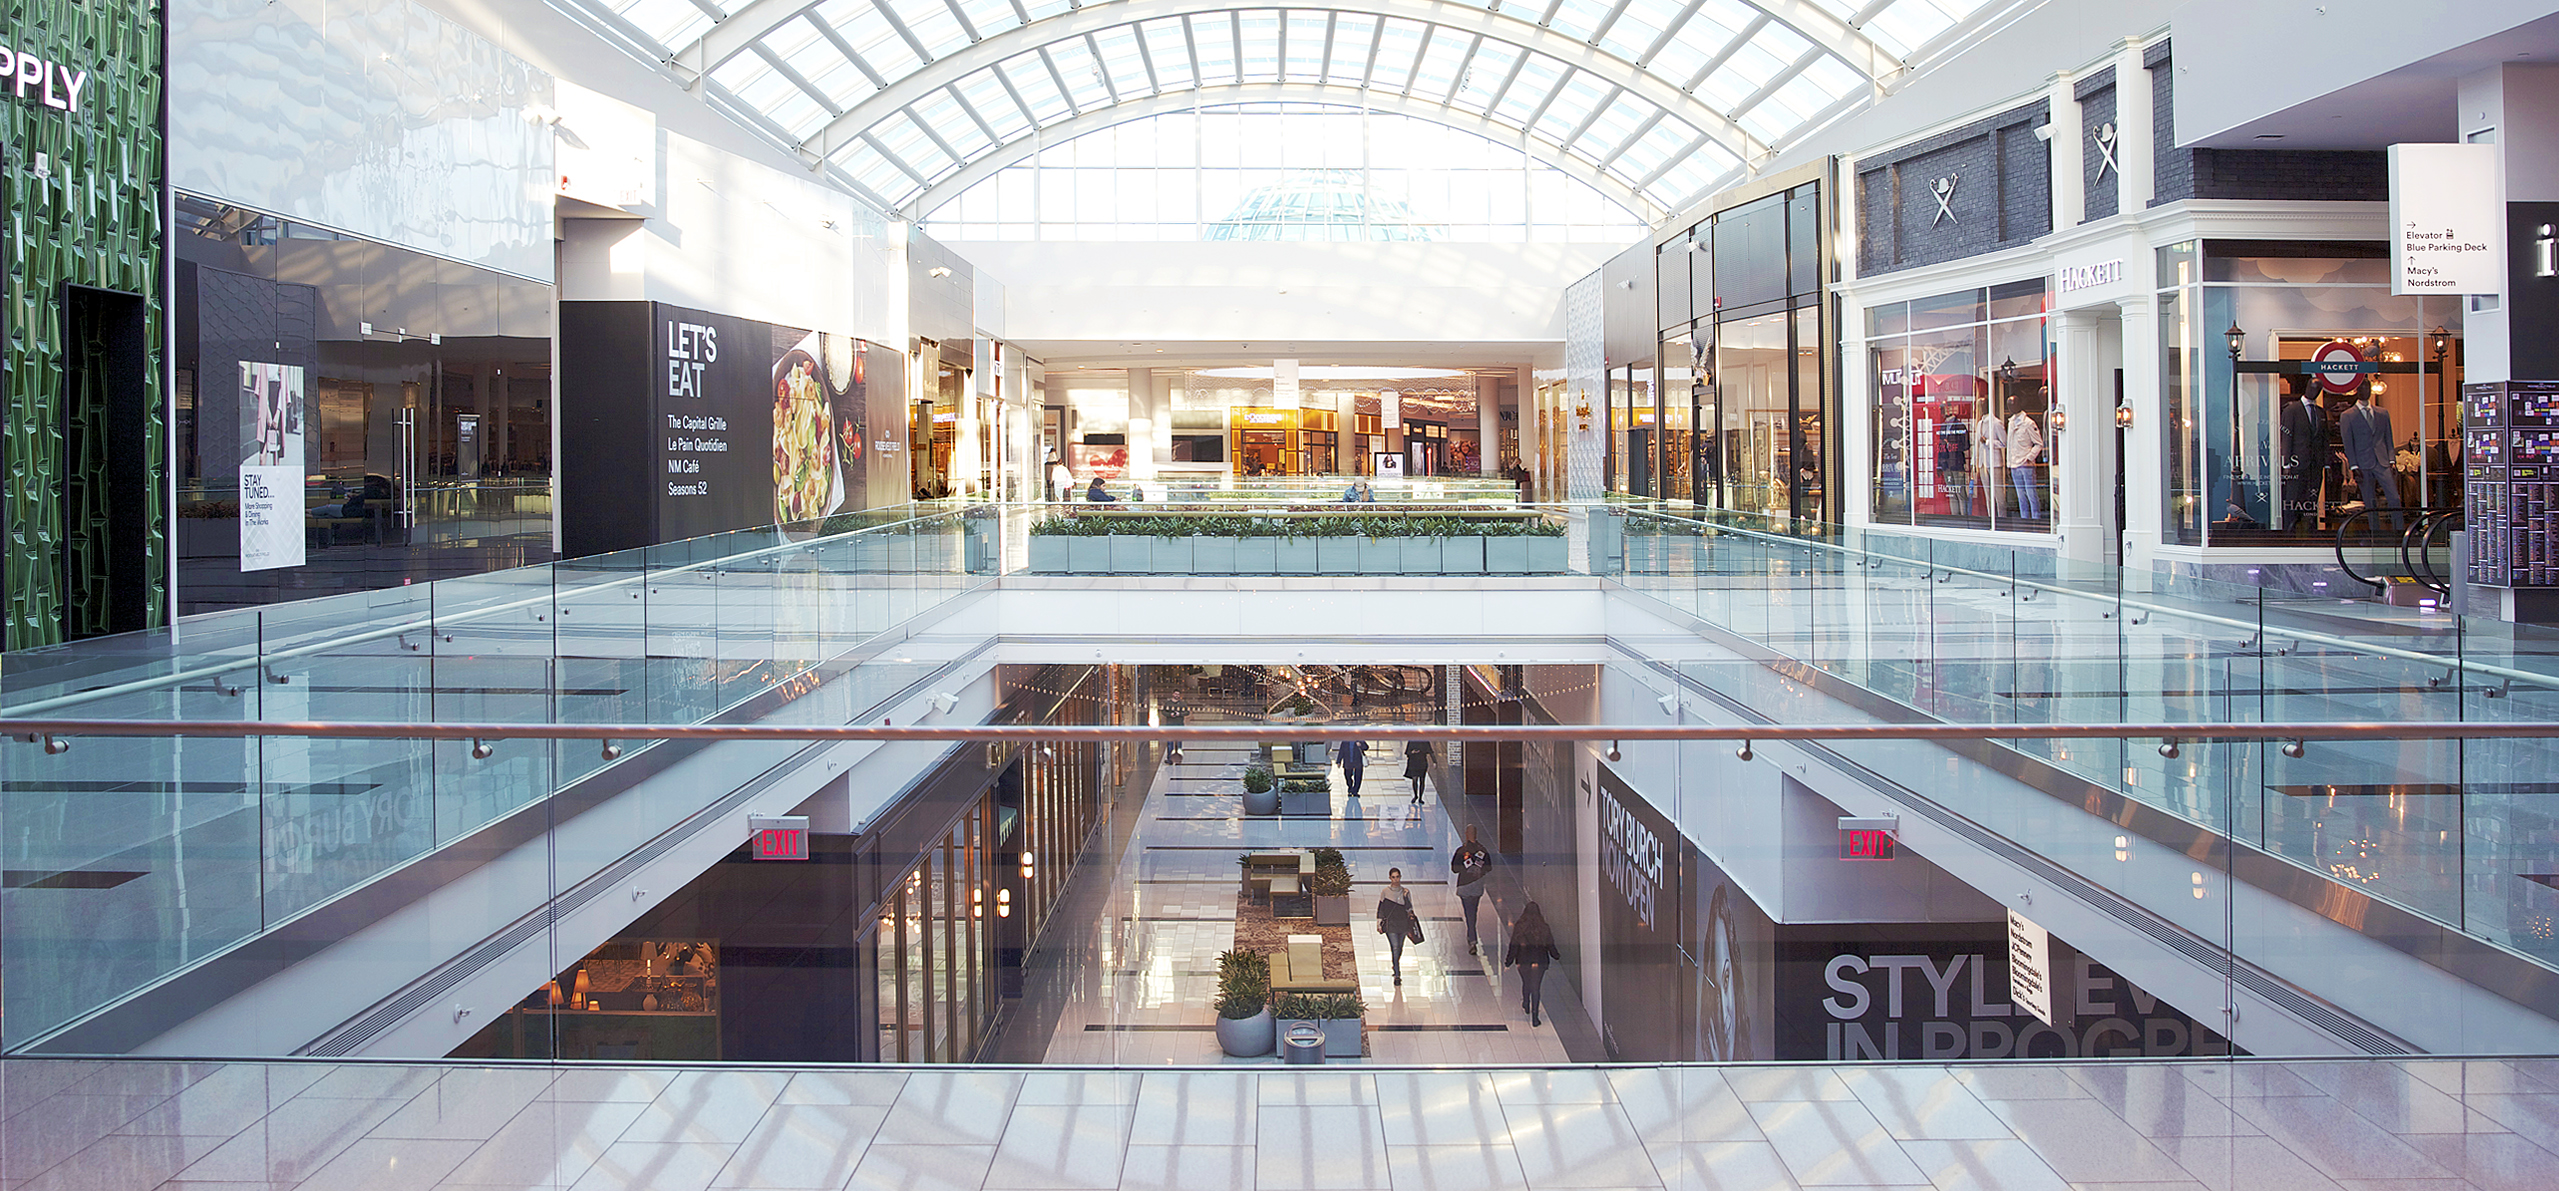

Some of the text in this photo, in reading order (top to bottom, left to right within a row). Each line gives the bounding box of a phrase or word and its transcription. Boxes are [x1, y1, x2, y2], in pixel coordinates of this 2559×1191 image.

[2406, 231, 2443, 240] Elevator
[2406, 243, 2488, 253] Blue Parking Deck
[2059, 258, 2124, 293] HACKETT
[2407, 266, 2439, 276] Macy's
[2407, 279, 2457, 288] Nordstrom
[669, 359, 706, 398] EAT
[667, 414, 728, 432] The Capital Grille
[668, 437, 729, 452] Le Pain Quotidien
[668, 459, 700, 474] NM Café
[2223, 454, 2300, 469] ARIVLS
[244, 474, 262, 487] STAY
[668, 480, 708, 496] Seasons 52
[1938, 484, 1961, 493] HACKETT
[255, 501, 273, 511] Shopping
[762, 829, 799, 856] EXIT
[1600, 785, 1664, 890] TORY BURCH
[1849, 830, 1886, 856] EXIT
[1602, 831, 1655, 933] NOW OPEN
[2010, 914, 2024, 931] Macy's
[2010, 928, 2033, 950] Nordstrom
[2012, 941, 2032, 963] JCPenney
[2012, 954, 2043, 981] Bloomingdale's
[1822, 953, 2034, 1019] STYL
[2012, 965, 2043, 993] Bloomingdale's
[2013, 986, 2025, 1002] Dick's
